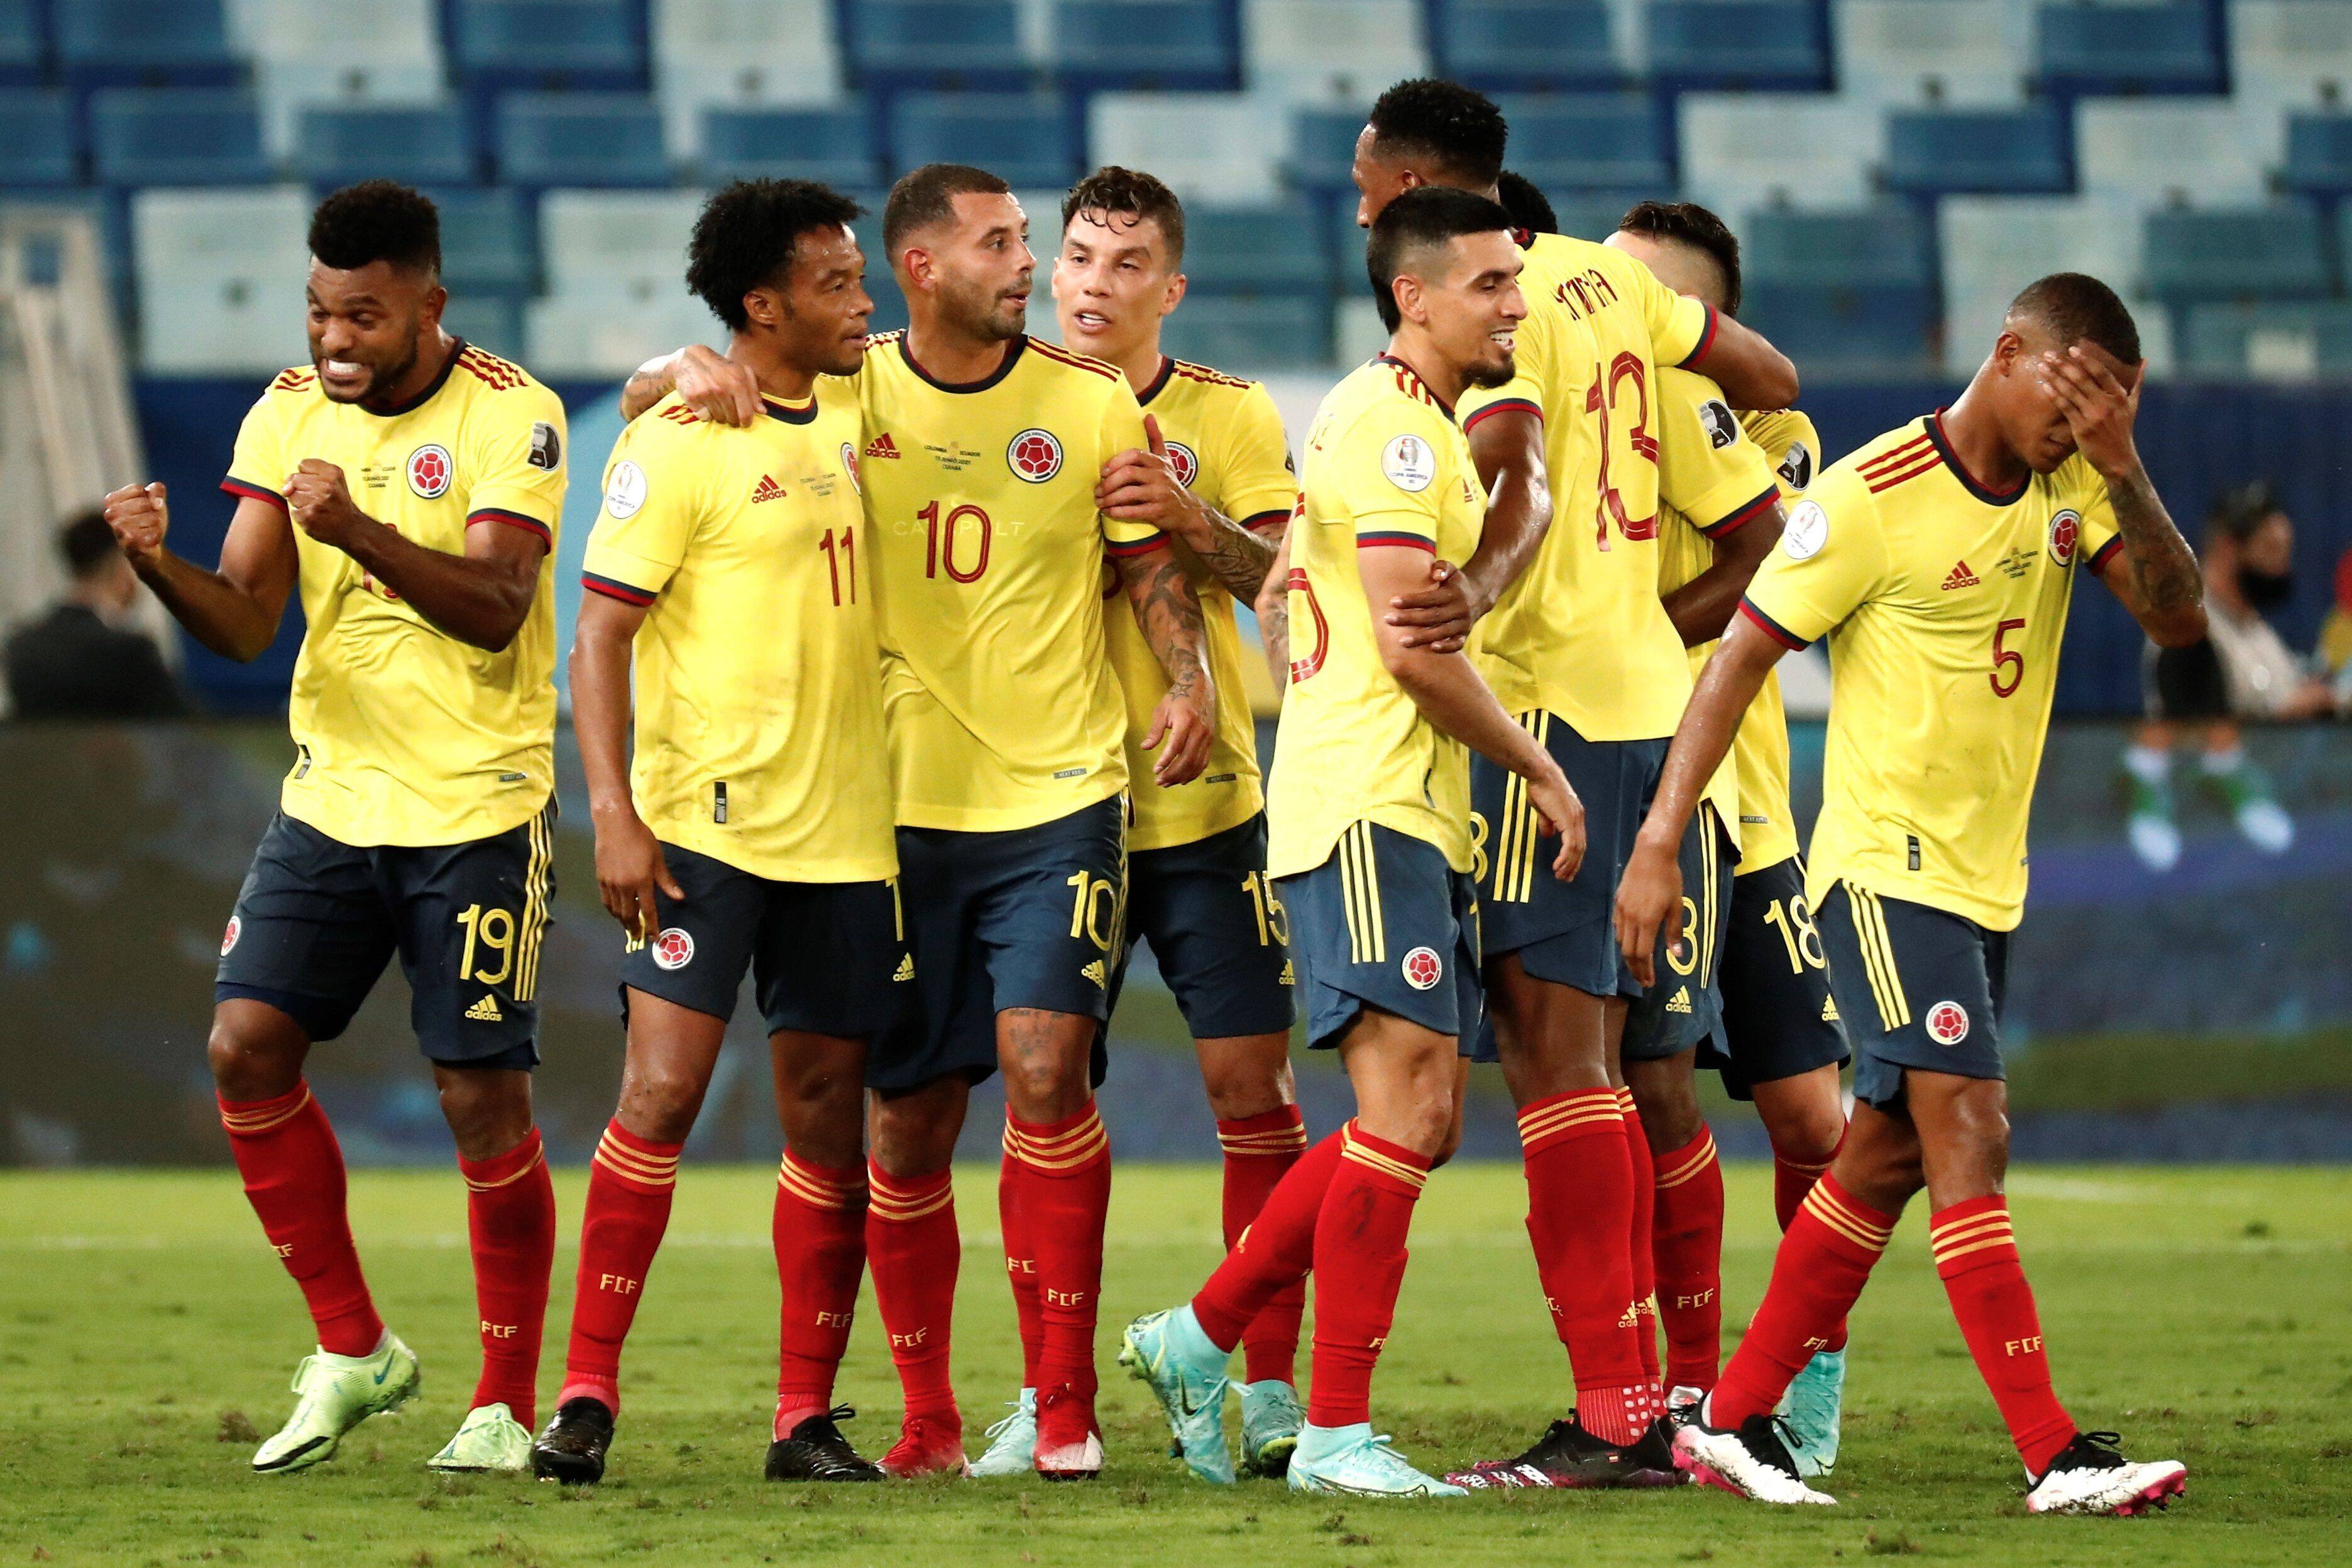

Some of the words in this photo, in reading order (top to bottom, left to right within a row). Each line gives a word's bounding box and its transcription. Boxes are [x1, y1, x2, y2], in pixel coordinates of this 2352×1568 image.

[865, 447, 901, 459] adidas
[1586, 350, 1660, 552] 13
[751, 490, 788, 504] adidas
[916, 500, 992, 584] 10
[819, 525, 856, 606] 11
[1941, 576, 1981, 591] adidas
[1989, 618, 2026, 698] 5
[1067, 870, 1117, 951] 10
[1241, 870, 1289, 946] 15
[456, 903, 515, 985] 19
[1763, 895, 1826, 974] 18
[464, 1009, 503, 1022] adidas
[270, 1244, 294, 1257] CF
[1008, 1257, 1036, 1274] FC
[599, 1273, 638, 1295] FCF
[1048, 1288, 1085, 1307] FCF
[1677, 1288, 1714, 1310] FCF
[481, 1320, 518, 1339] FCF
[815, 1311, 852, 1328] FCF
[891, 1326, 927, 1347] FCF
[2005, 1335, 2042, 1357] FCF
